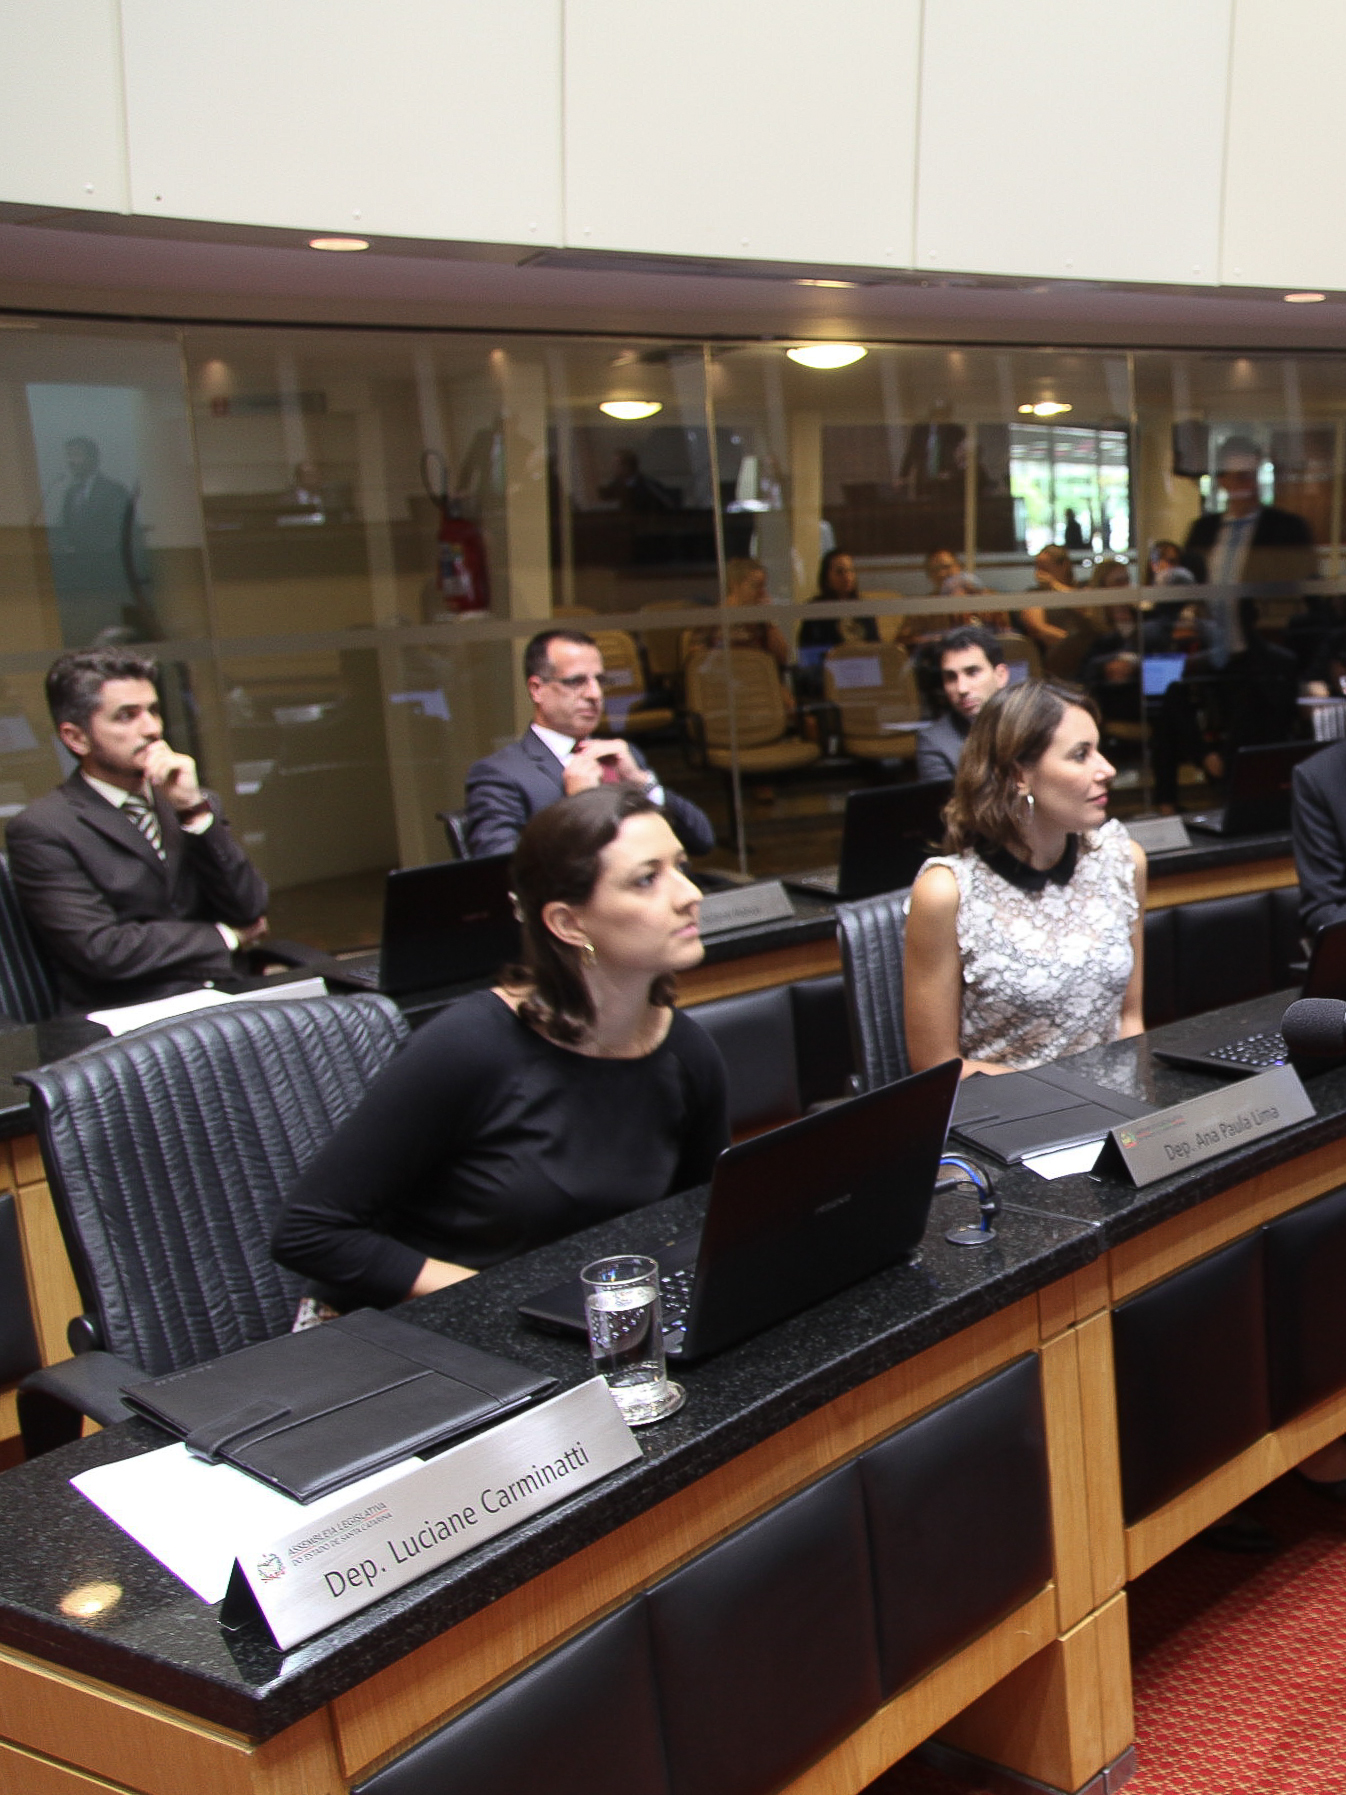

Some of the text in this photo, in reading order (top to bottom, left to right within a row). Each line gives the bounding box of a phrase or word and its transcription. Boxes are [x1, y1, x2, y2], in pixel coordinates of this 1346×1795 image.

[1163, 1104, 1279, 1161] Dep. Ana Paula Lima
[323, 1441, 590, 1598] Dep. Luciane Carminatti
